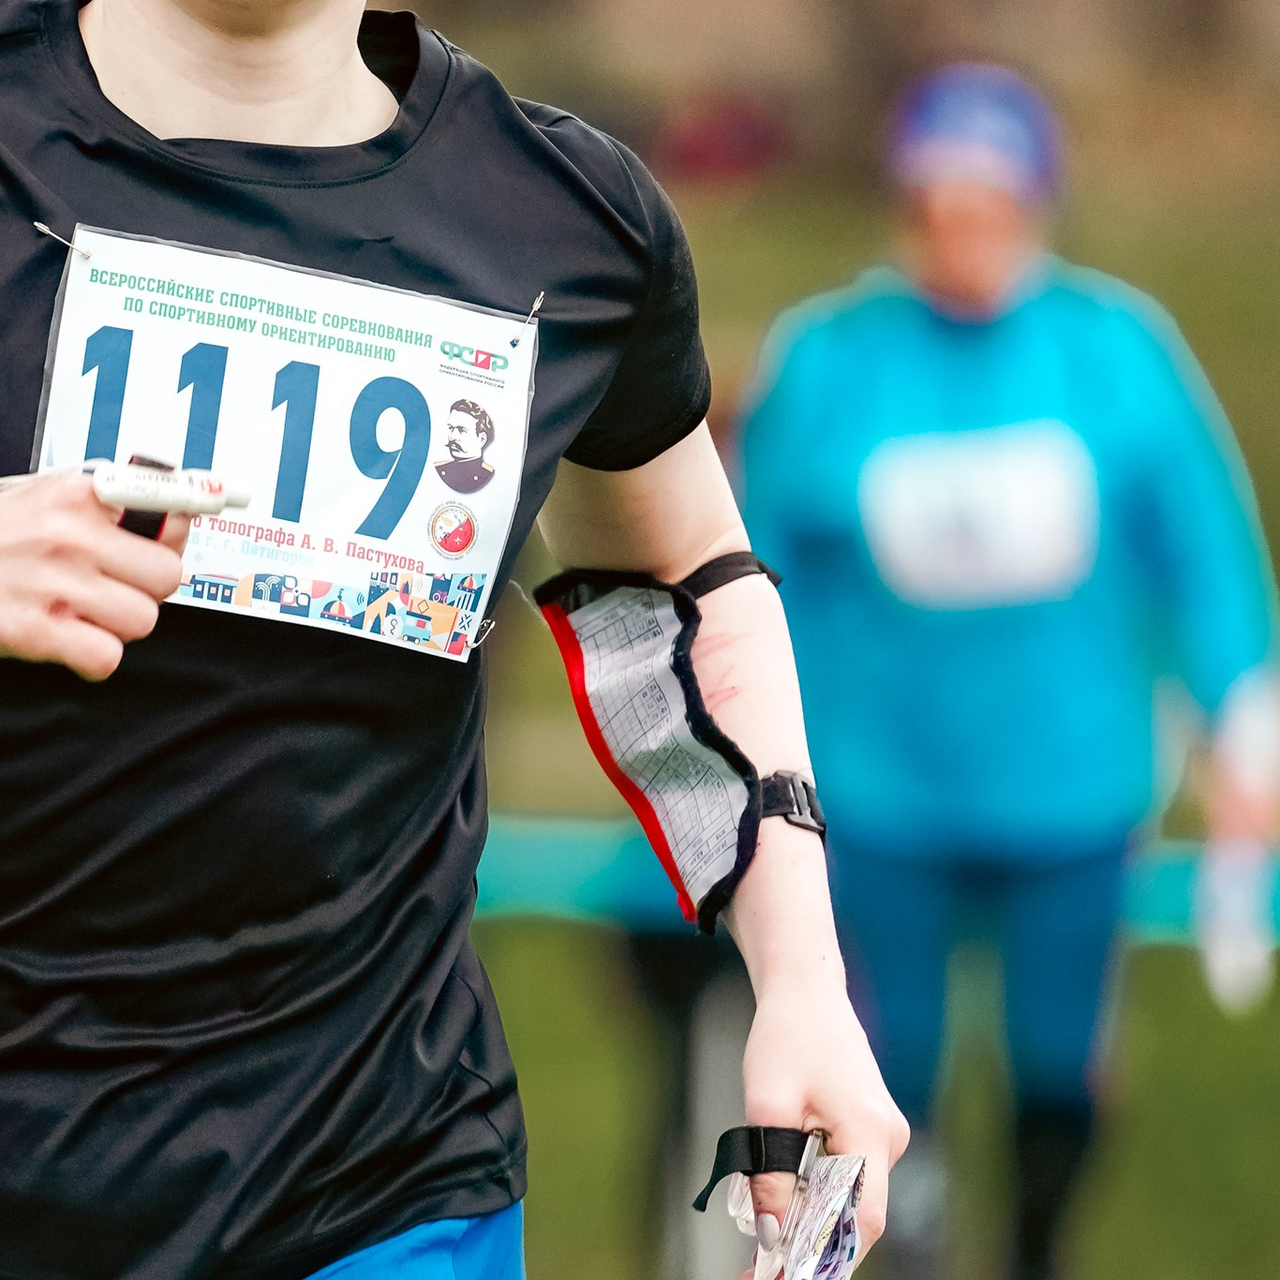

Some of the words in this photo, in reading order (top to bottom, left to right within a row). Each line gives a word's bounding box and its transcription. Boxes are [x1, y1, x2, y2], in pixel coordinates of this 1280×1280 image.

[89, 268, 215, 304] ВСЕРОССИЙСКИЕ
[220, 291, 317, 325] СПОРТИВНЫЕ
[322, 312, 433, 349] СОРЕВНОВАНИЯ
[123, 297, 143, 313] ПО
[149, 301, 257, 333] СПОРТИВНОМУ
[261, 322, 396, 363] ОРИЕНТИРОВАНИЮ
[81, 325, 431, 540] 1119
[209, 516, 295, 547] топографа
[301, 533, 316, 550] А.
[323, 537, 338, 554] В.
[346, 541, 425, 574] Пастухова
